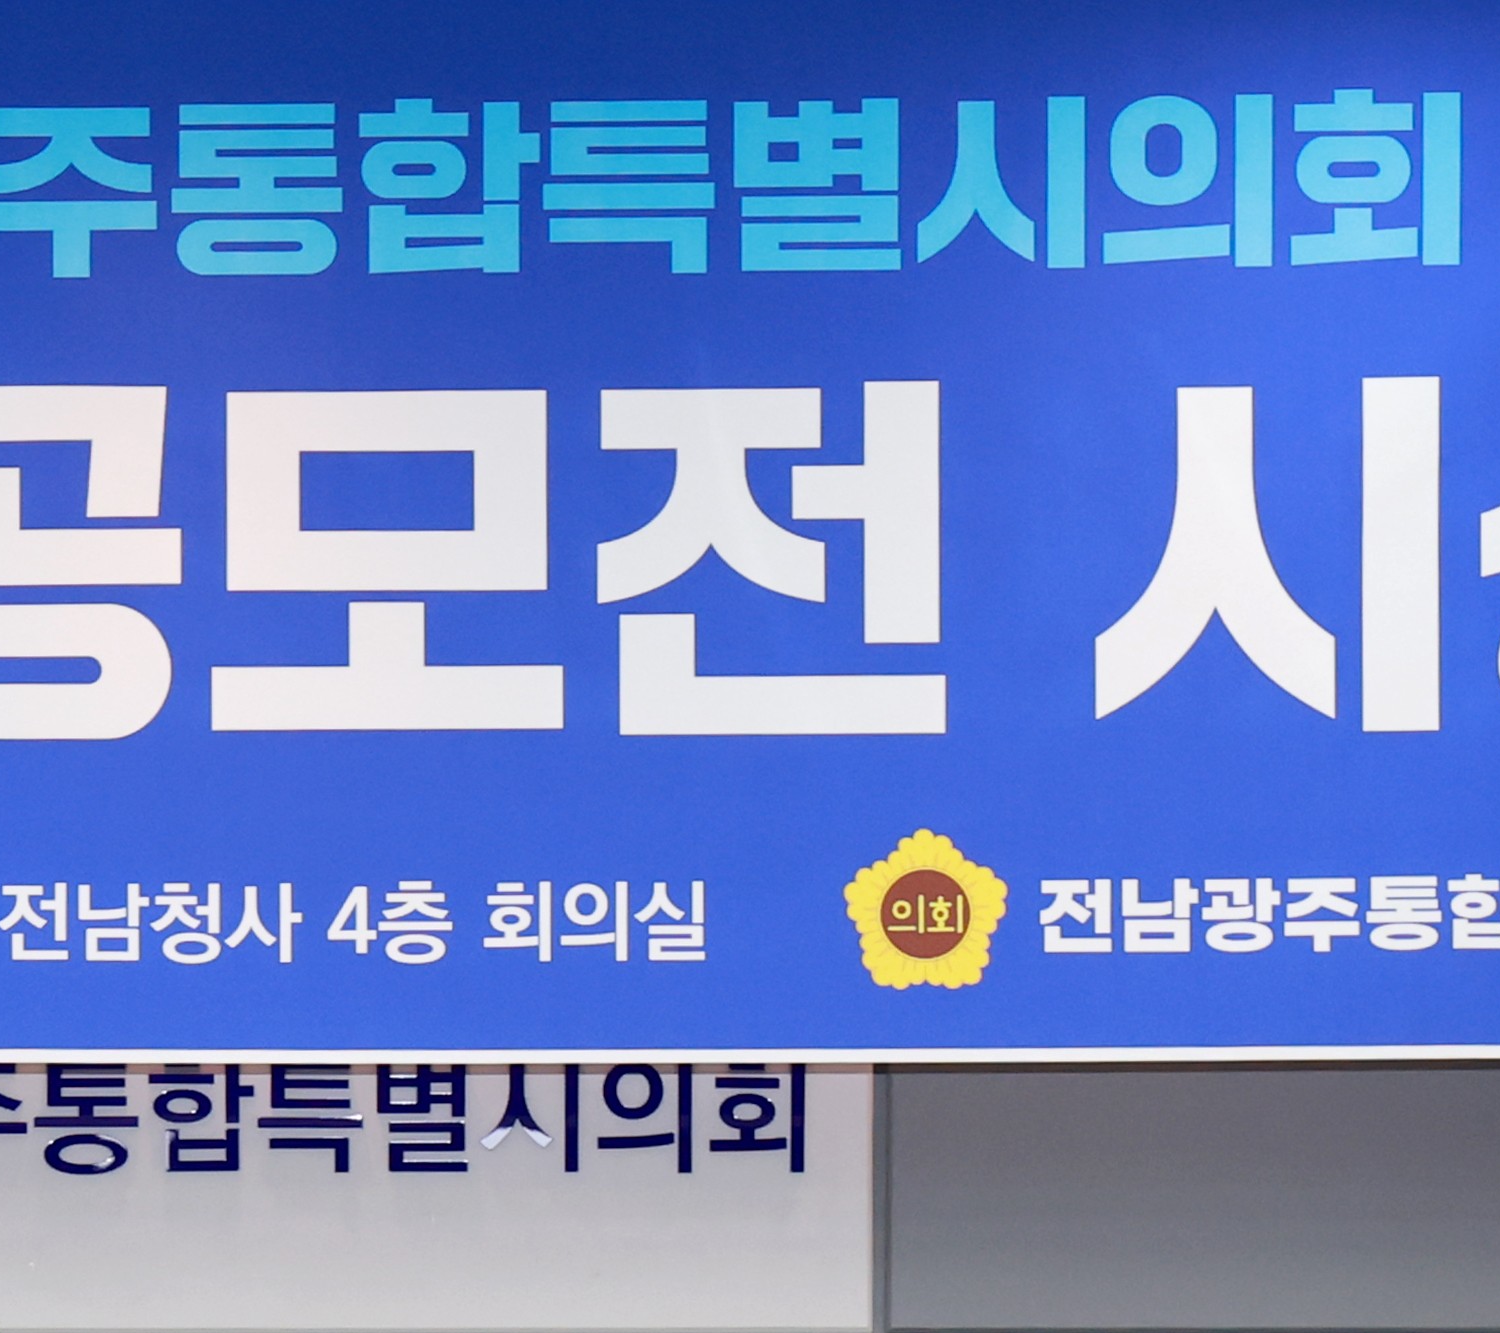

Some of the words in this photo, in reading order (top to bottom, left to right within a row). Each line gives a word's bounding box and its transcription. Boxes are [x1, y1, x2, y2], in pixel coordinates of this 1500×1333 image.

[327, 880, 454, 965] 4층
[483, 880, 706, 963] 회의실
[886, 893, 965, 935] 의회
